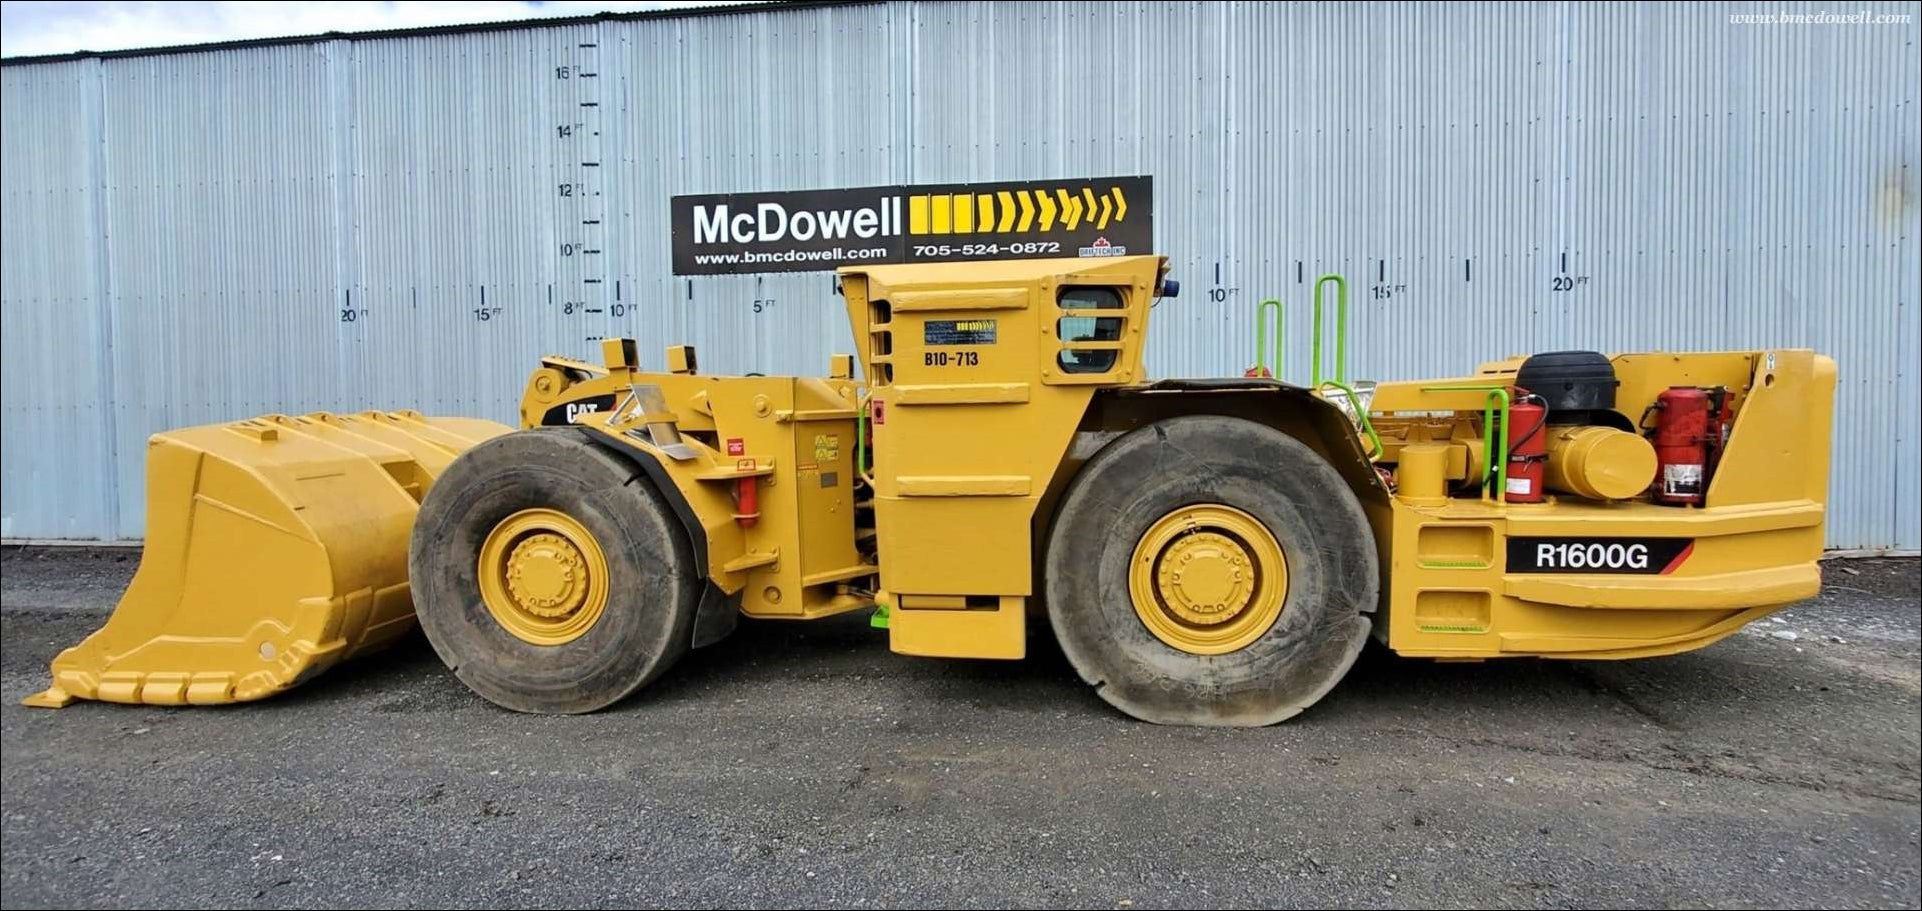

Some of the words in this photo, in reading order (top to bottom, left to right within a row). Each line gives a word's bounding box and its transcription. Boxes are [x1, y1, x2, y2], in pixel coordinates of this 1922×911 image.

[556, 66, 570, 80] 16
[557, 125, 571, 139] 14
[558, 183, 572, 197] 12
[693, 196, 901, 244] McDowell
[560, 243, 573, 257] 10
[695, 247, 887, 265] www.bmcdowell.com
[913, 242, 1061, 256] 705-524-0872
[1394, 285, 1407, 293] FT
[1553, 276, 1574, 291] 20
[1577, 276, 1590, 284] FT
[1209, 288, 1226, 302] 10
[1228, 288, 1239, 296] FT
[564, 302, 573, 315] 8
[610, 304, 625, 317] 10
[753, 300, 762, 313] 5
[765, 300, 775, 308] FT
[341, 309, 356, 322] 20
[472, 308, 490, 321] 15
[492, 307, 503, 315] FT
[925, 352, 978, 366] B10-713
[1537, 543, 1648, 569] R1600G
